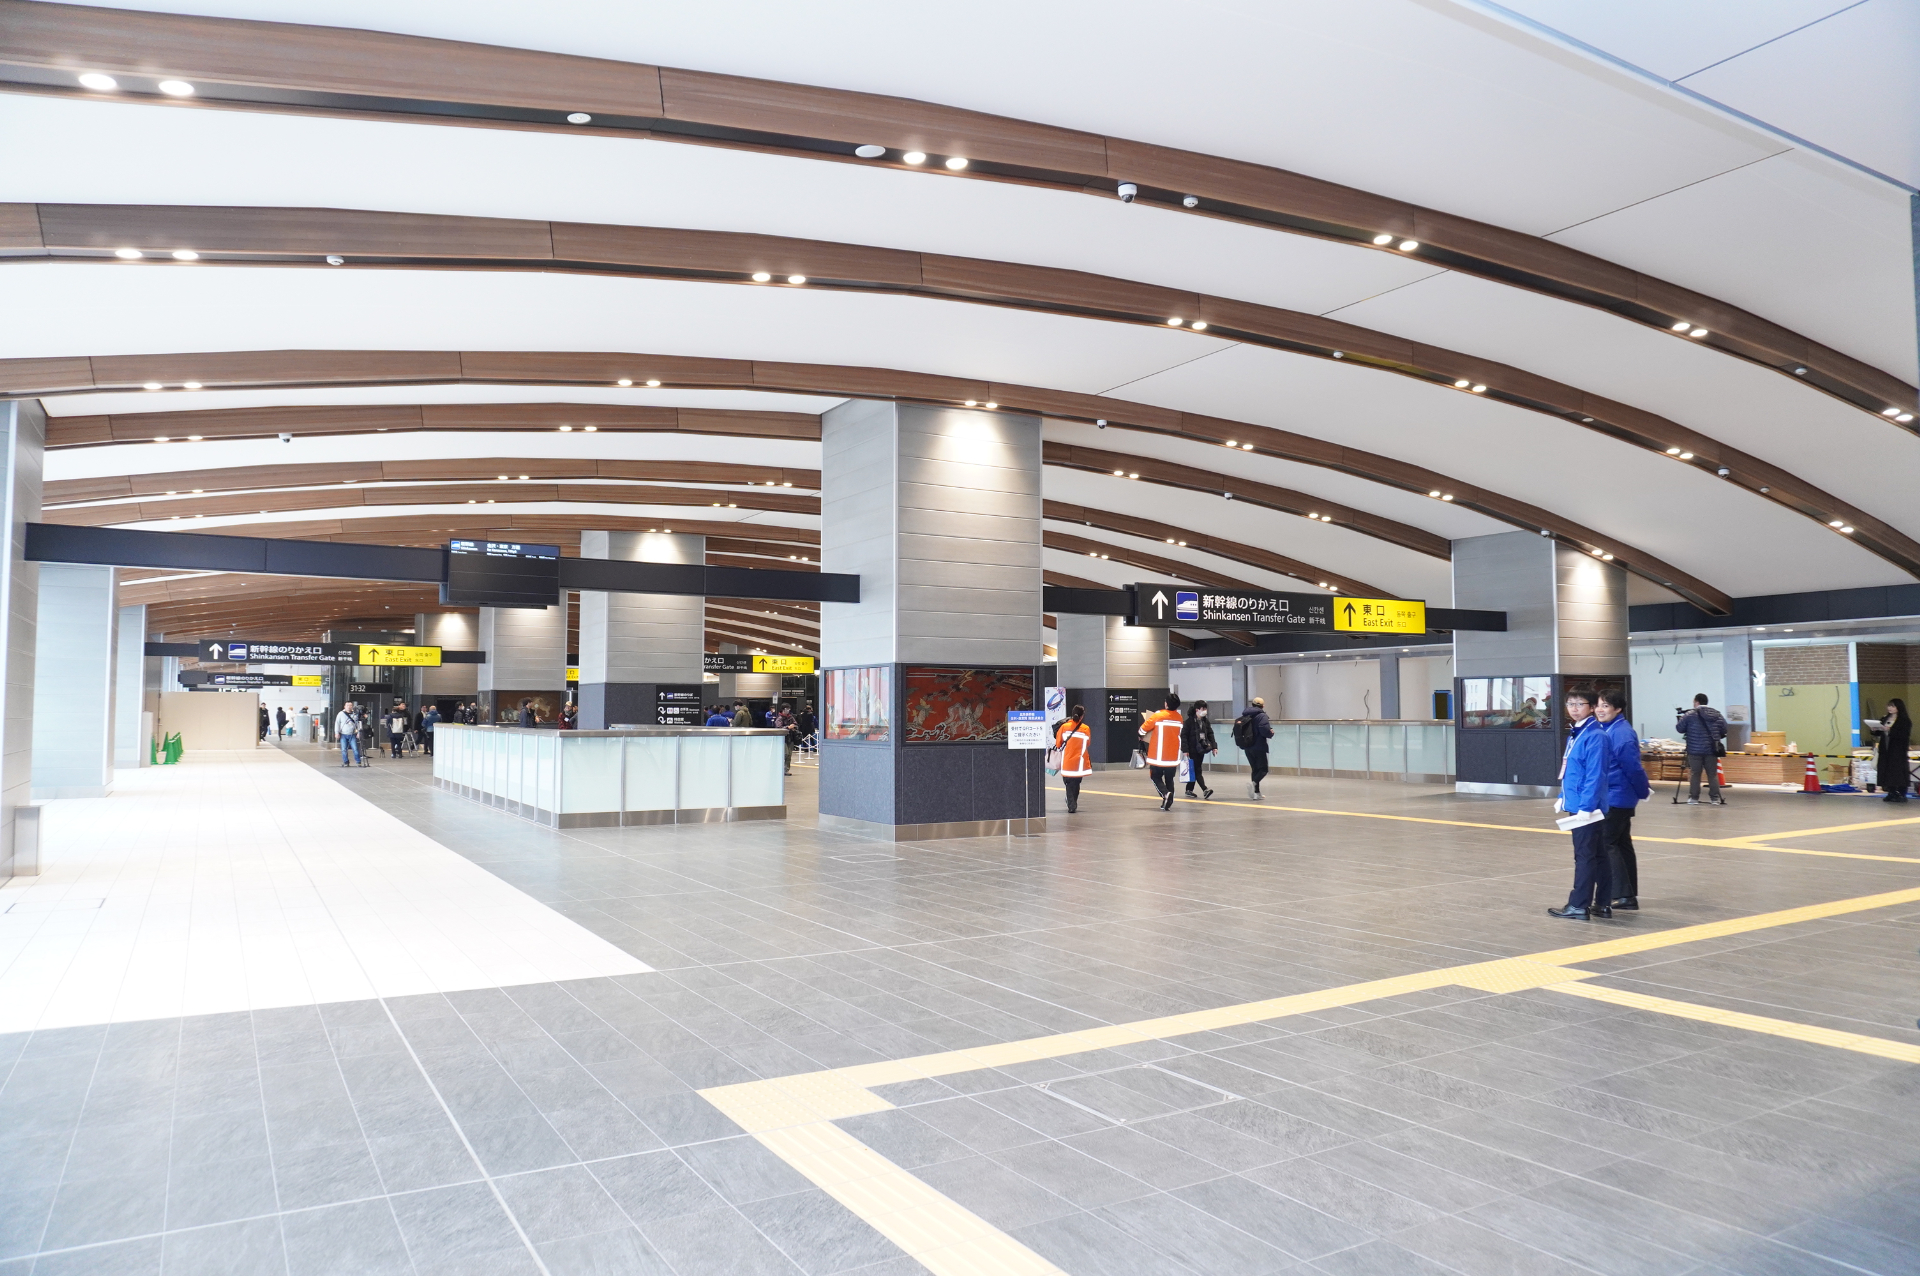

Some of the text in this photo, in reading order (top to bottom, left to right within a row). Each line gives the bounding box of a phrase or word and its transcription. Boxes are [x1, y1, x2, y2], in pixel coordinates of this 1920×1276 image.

[1202, 594, 1289, 612] 新幹線のりかえ口
[1203, 609, 1306, 624] Shinkansen Transfer Gate
[1364, 618, 1393, 627] East Exit
[250, 645, 322, 654] 新幹線のりかえ口
